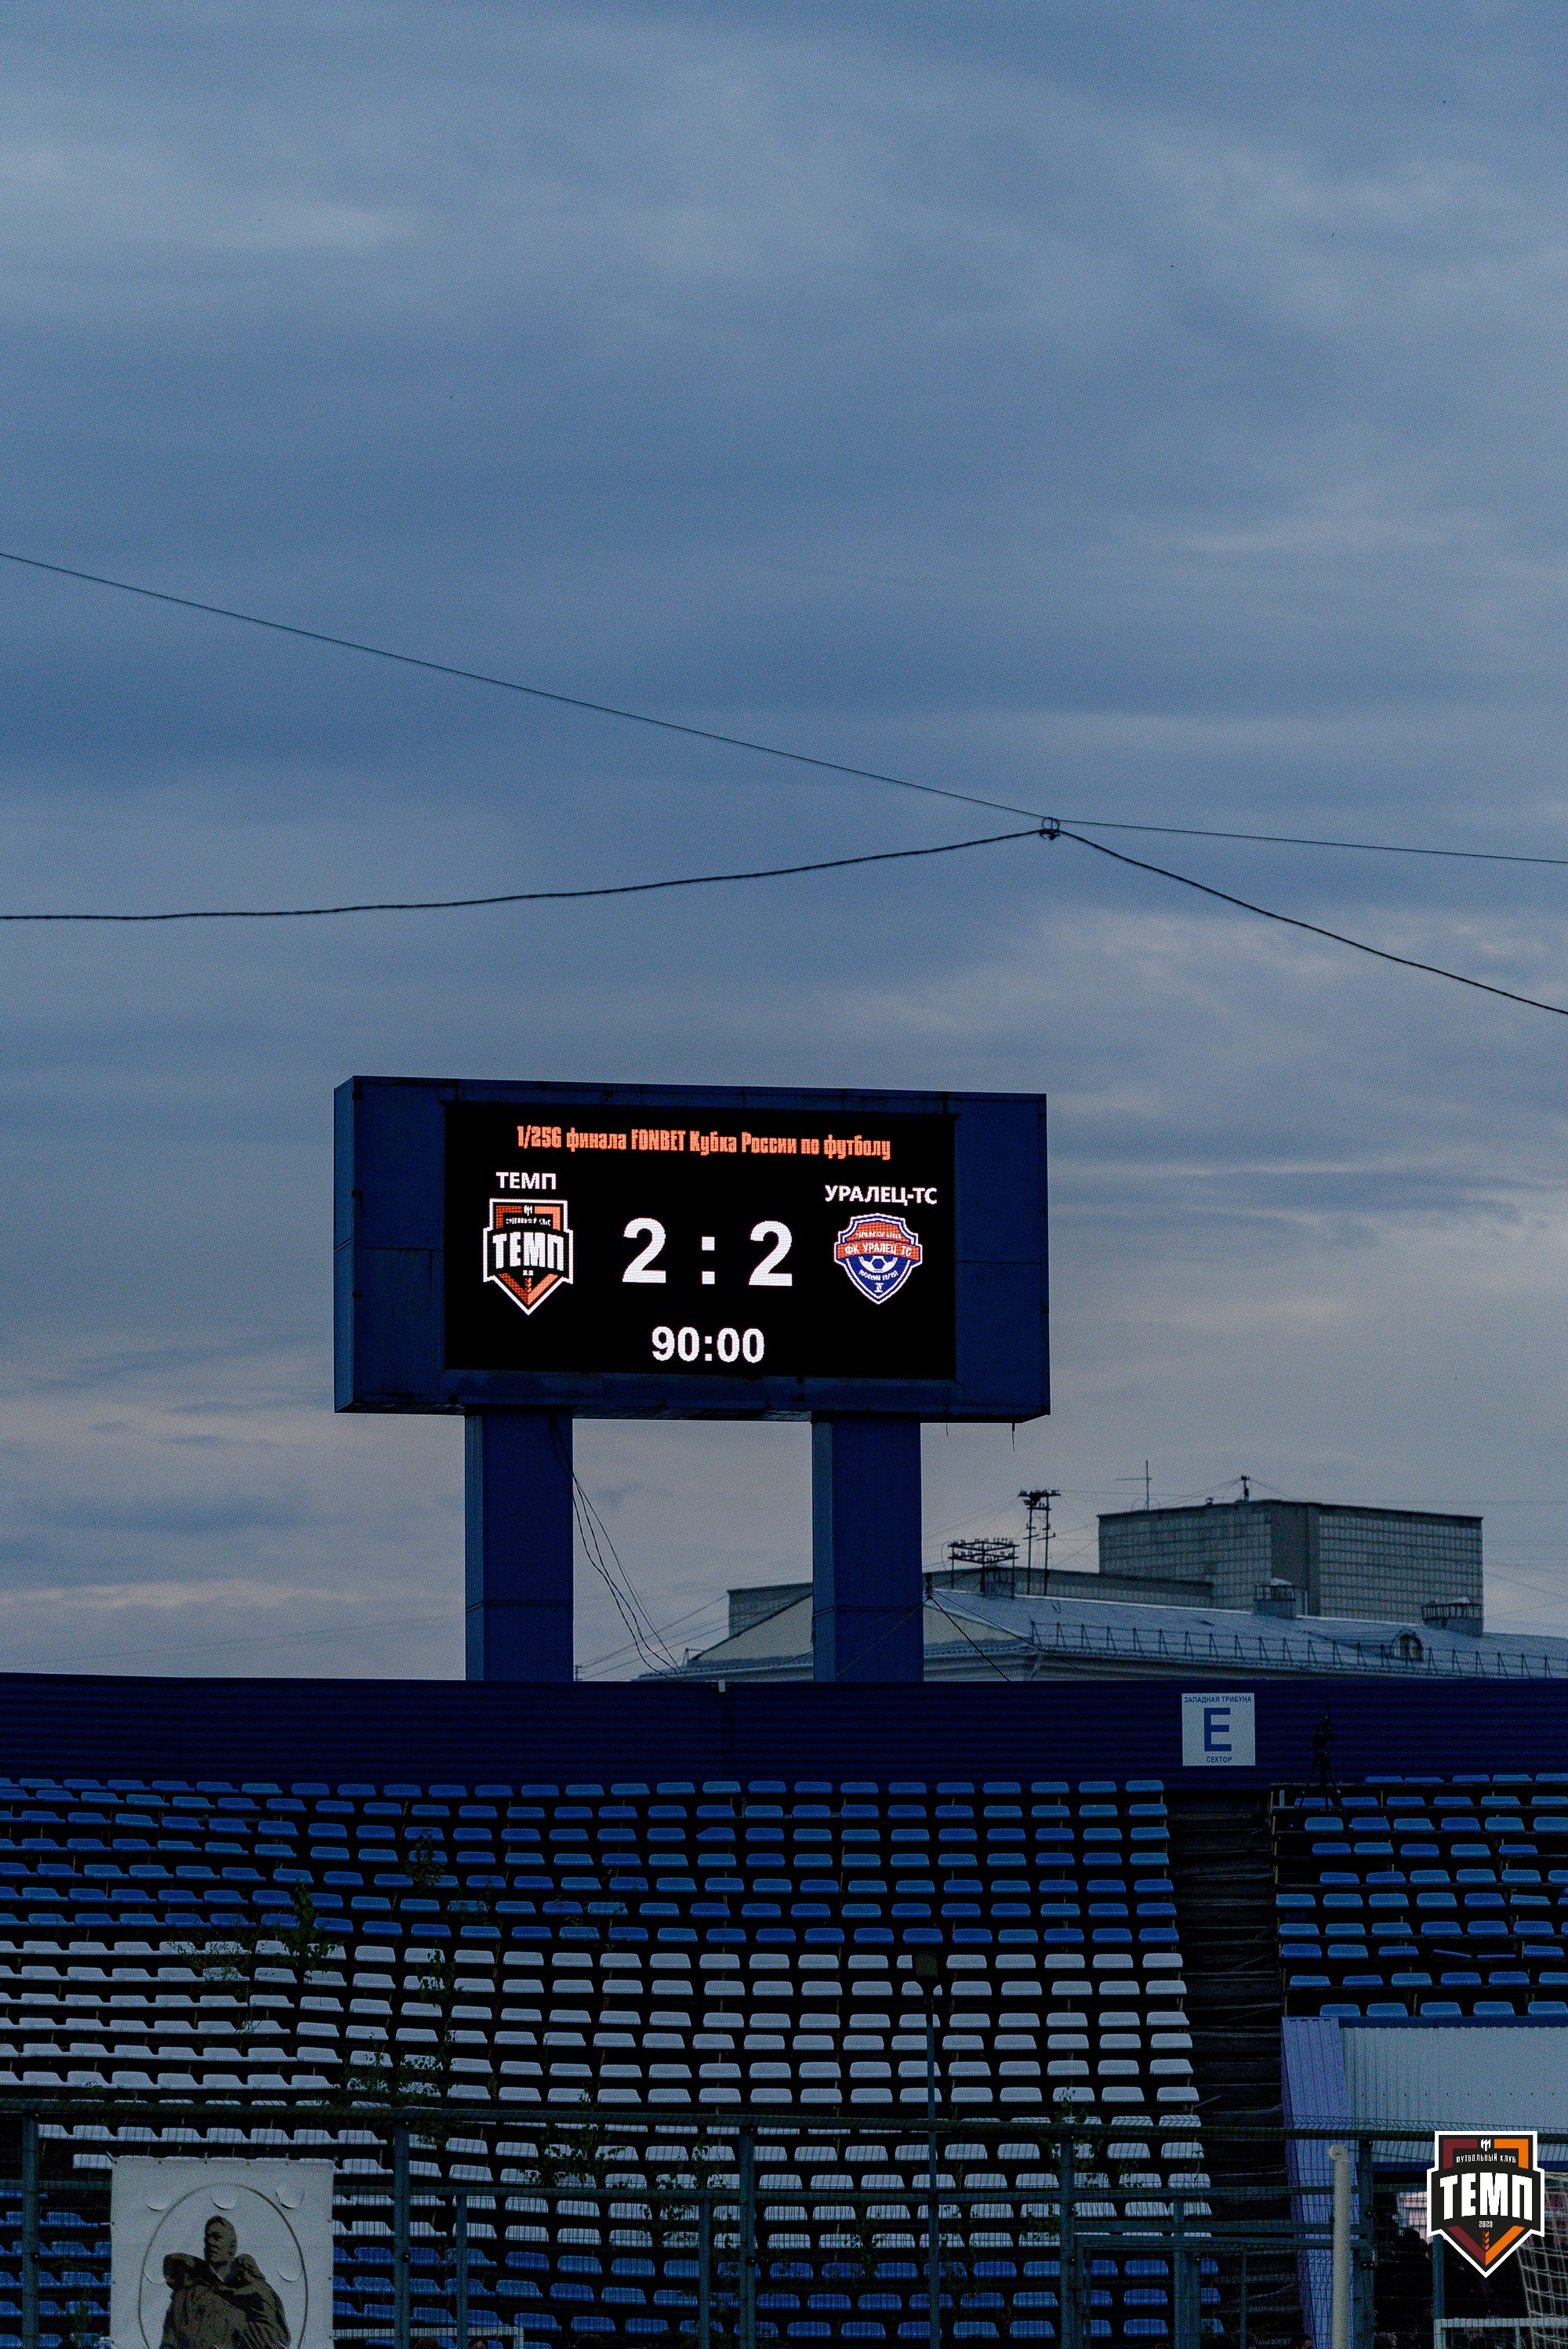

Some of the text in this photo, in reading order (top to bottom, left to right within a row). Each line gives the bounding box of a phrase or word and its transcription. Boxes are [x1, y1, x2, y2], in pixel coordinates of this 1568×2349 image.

[517, 1125, 891, 1161] 1/256 финала FONBET Кубка России по футболу
[495, 1171, 557, 1190] ТЕМП
[824, 1184, 938, 1207] УРАЛЕЦ-ТС
[492, 1232, 564, 1272] ТЕМП
[622, 1217, 666, 1283] 2
[748, 1220, 793, 1287] 2
[844, 1243, 913, 1257] ФК УРАЛЕЦ ТС
[652, 1326, 765, 1363] 90:00
[1204, 1708, 1232, 1752] Е
